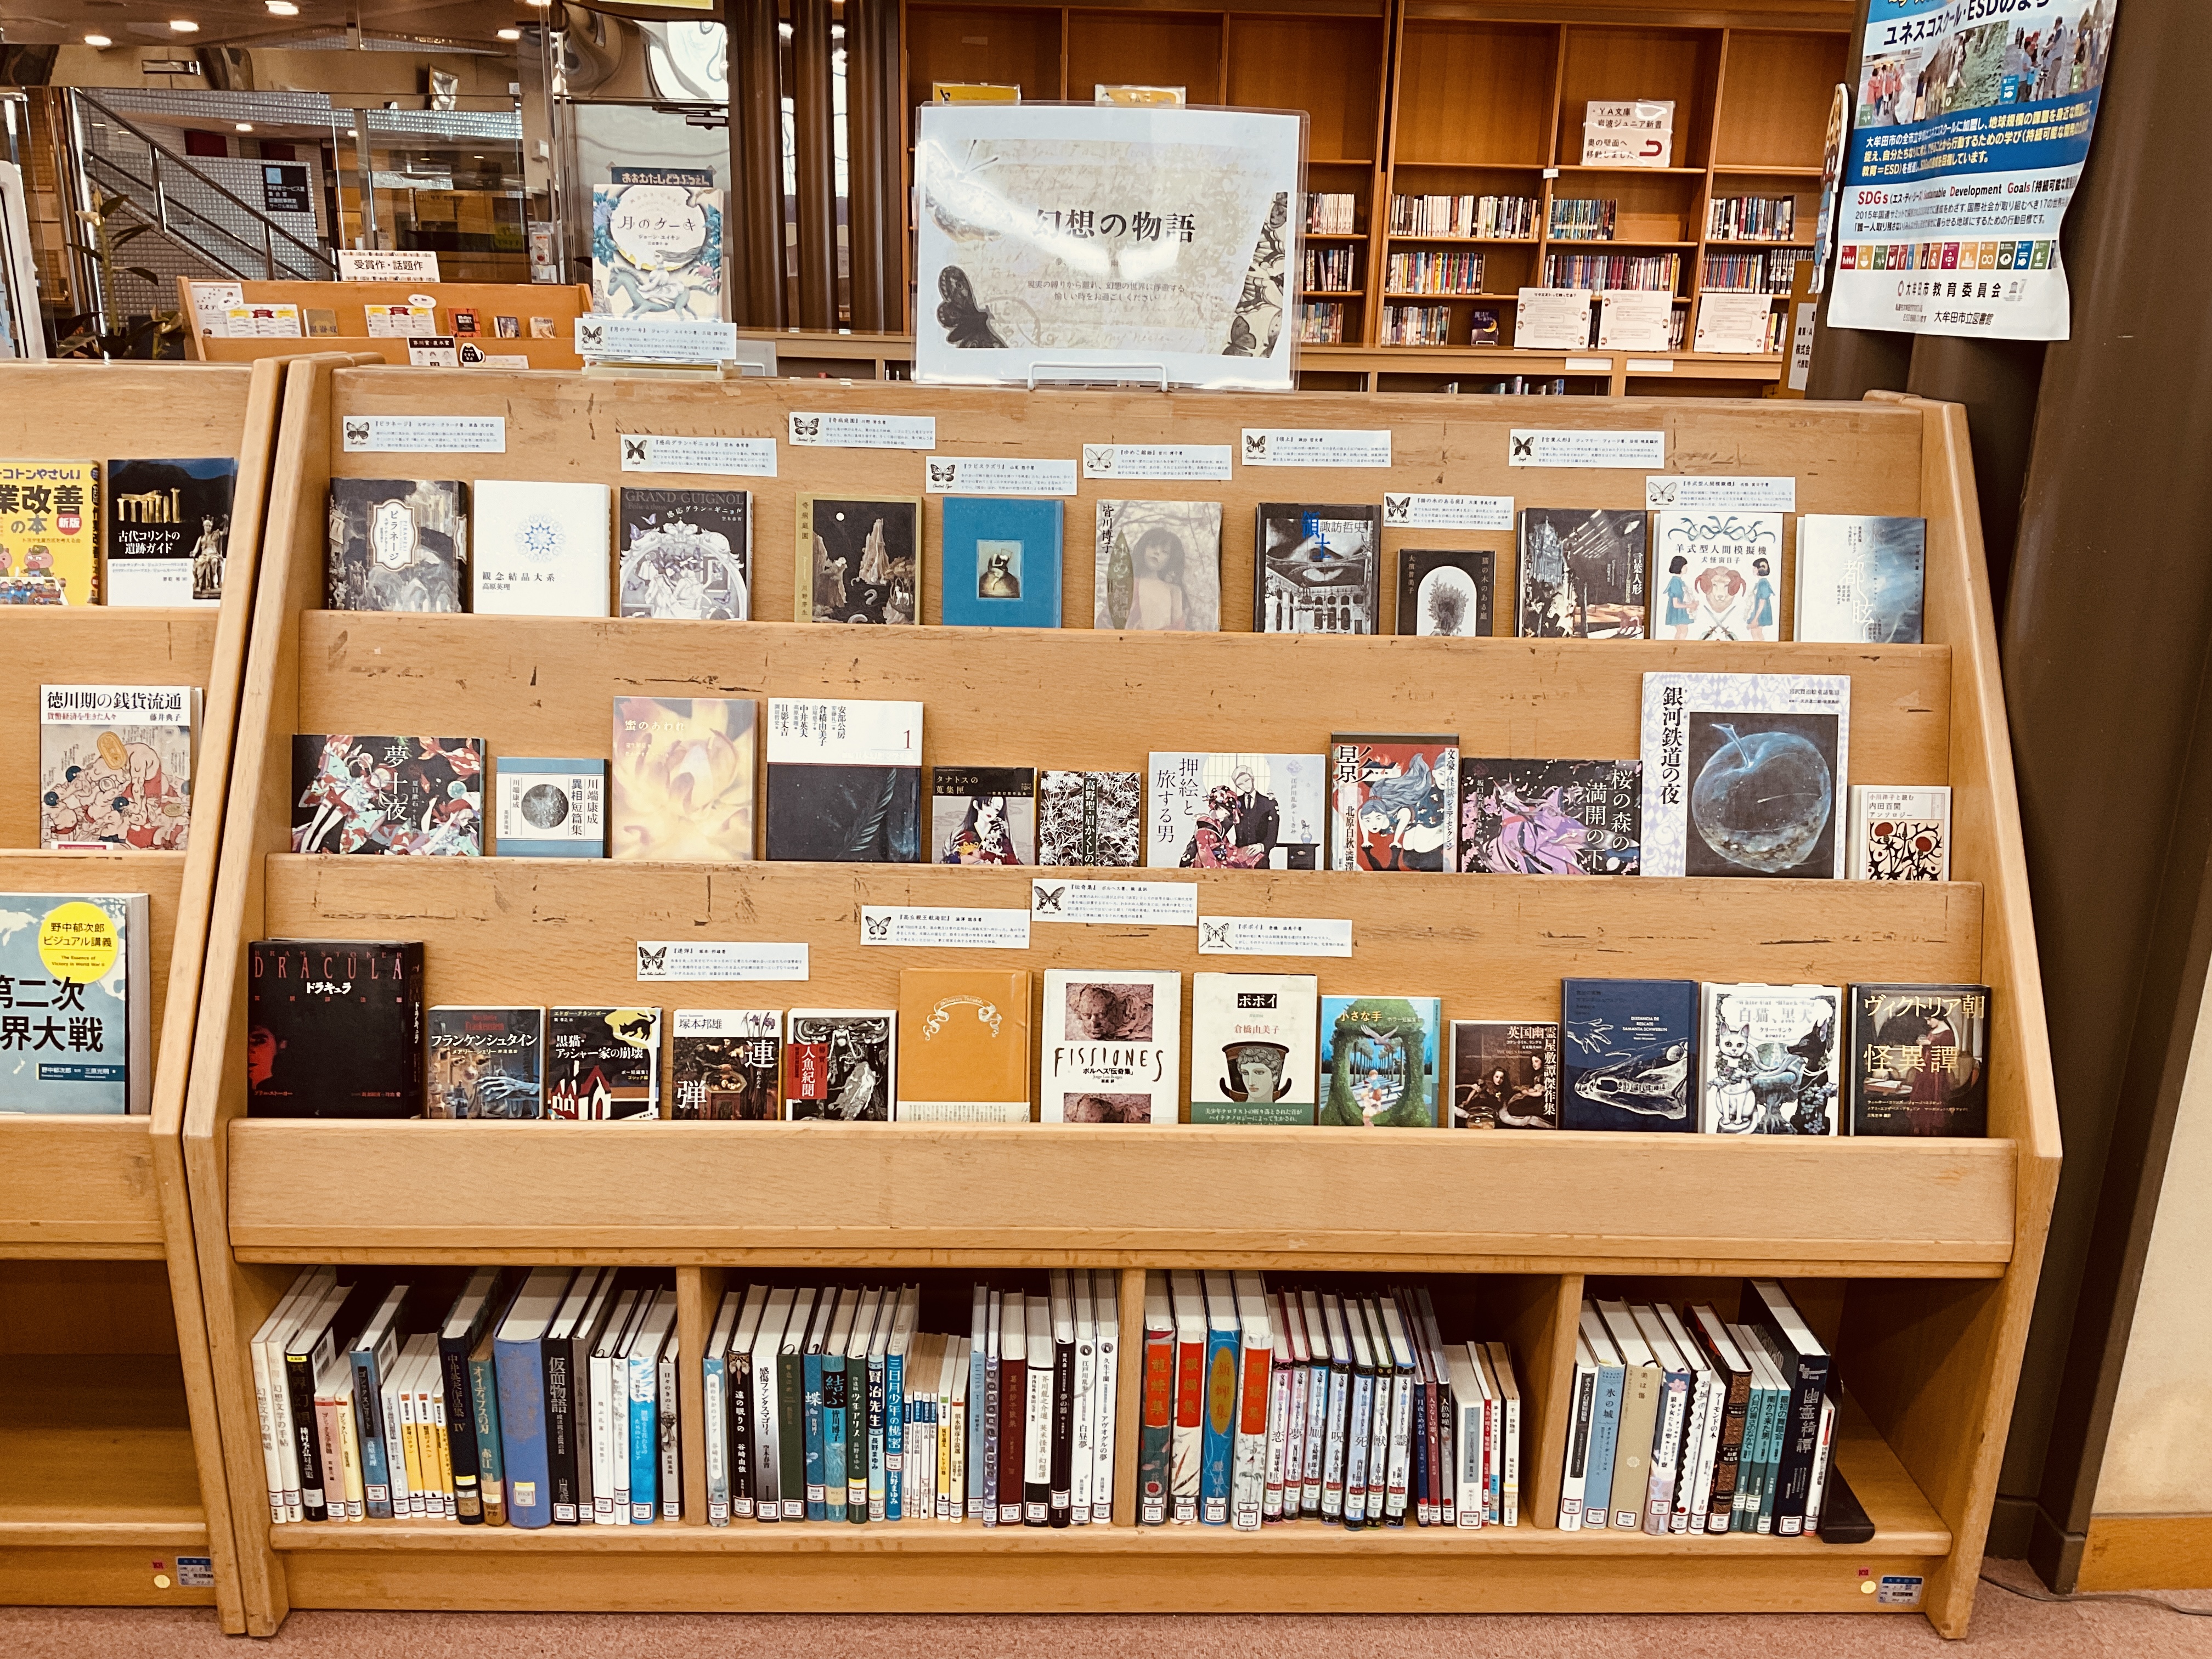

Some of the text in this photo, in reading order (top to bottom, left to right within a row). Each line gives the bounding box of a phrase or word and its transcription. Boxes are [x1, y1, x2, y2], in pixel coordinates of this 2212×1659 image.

[1598, 119, 1662, 129] 岩波ジュニア新書
[1588, 138, 1627, 146] 奥の壁面へ
[622, 172, 710, 185] おおむたしどうぶつえん
[1858, 182, 2030, 205] SDGs Development Goals
[618, 216, 696, 232] 月のケーキ
[1032, 210, 1196, 243] 幻想の物語
[353, 259, 424, 270] 受賞作・話題作
[1934, 311, 1994, 325] 大牟田市立図書館
[0, 469, 80, 480] コトンやさしい
[625, 492, 744, 505] GRAND GUIGNOL
[11, 515, 47, 535] の本
[58, 517, 81, 529] 新版
[802, 501, 810, 540] 奇病庭園
[1101, 504, 1115, 554] 皆川博子
[1319, 521, 1366, 533] 諏訪哲史
[118, 531, 180, 543] 古代コリントの
[389, 510, 399, 561] ピラネージ
[1301, 511, 1331, 559] 領土
[125, 542, 173, 555] 遺跡ガイド
[1676, 543, 1768, 556] 羊式型人間模擬機
[482, 572, 555, 582] 観念結晶大系
[1632, 552, 1643, 595] 言葉人形
[1480, 556, 1490, 621] 猫の木のある庭
[47, 692, 182, 710] 徳川期の銭貨流通
[47, 713, 116, 721] 貨幣経済を生きた人々
[149, 714, 182, 722] 藤井典子
[625, 720, 685, 732] 蜜のあわれ
[781, 704, 789, 736] 日影丈吉
[799, 704, 808, 738] 中井英夫
[819, 705, 827, 746] 倉橋由美子
[837, 705, 847, 739] 安部公房
[904, 730, 912, 749] 1
[1660, 686, 1684, 805] 銀河鉄道の夜
[1336, 745, 1375, 784] 影
[383, 745, 409, 822] 夢十夜
[935, 786, 966, 794] 蒐集匣
[936, 776, 978, 784] タナトスの
[1179, 758, 1199, 816] 押絵と
[512, 778, 520, 809] 川端康成
[586, 778, 599, 825] 川端康成
[571, 778, 583, 836] 異相短篇集
[1156, 770, 1176, 843] 旅する男
[1610, 769, 1632, 851] 桜の森の
[1085, 779, 1096, 866] 高野聖・眉かくしの
[1585, 782, 1607, 868] 満開の下
[50, 922, 105, 933] 野中郁次郎
[44, 936, 112, 947] ビジュアル講義
[255, 956, 403, 980] DRACULA
[307, 981, 352, 995] ドラキュラ
[1238, 993, 1277, 1008] ポポイ
[1863, 994, 1985, 1019] ヴィクトリア朝
[679, 1019, 723, 1030] 塚本邦雄
[1339, 1009, 1383, 1023] 小さな手
[1739, 1007, 1813, 1024] 白猫、黒犬
[1, 1015, 104, 1052] 界大戦
[431, 1034, 538, 1048] フランケンシュタイン
[1234, 1024, 1280, 1035] 倉橋由美子
[555, 1047, 644, 1060] アッシャー家の崩壊
[744, 1039, 775, 1069] 連
[1863, 1043, 1960, 1074] 怪異譚
[800, 1046, 816, 1097] 人魚紀聞
[676, 1080, 707, 1109] 弾
[549, 1357, 568, 1413] 仮面物語
[825, 1375, 845, 1405] 結ぶ
[805, 1391, 822, 1406] 蝶
[868, 1370, 882, 1426] 賢治先生
[888, 1359, 901, 1449] 三日月少年の秘密
[1602, 1387, 1616, 1419] 氷の城
[735, 1390, 746, 1433] 遠の眠りの
[851, 1393, 860, 1437] 少年アリス
[1710, 1392, 1723, 1439] アーモンドの木
[1743, 1393, 1759, 1450] 八月の暑さのなかで
[1760, 1395, 1776, 1441] 南から来た男
[1774, 1395, 1789, 1441] 最初の舞踏会
[1795, 1387, 1820, 1453] 幽霊綺譚
[1272, 1430, 1284, 1443] 恋
[1289, 1427, 1303, 1440] 夢
[1308, 1426, 1322, 1439] 厠
[1331, 1431, 1344, 1443] 呪
[1355, 1436, 1369, 1448] 死
[1373, 1435, 1386, 1447] 獣
[737, 1443, 747, 1473] 谷崎由依
